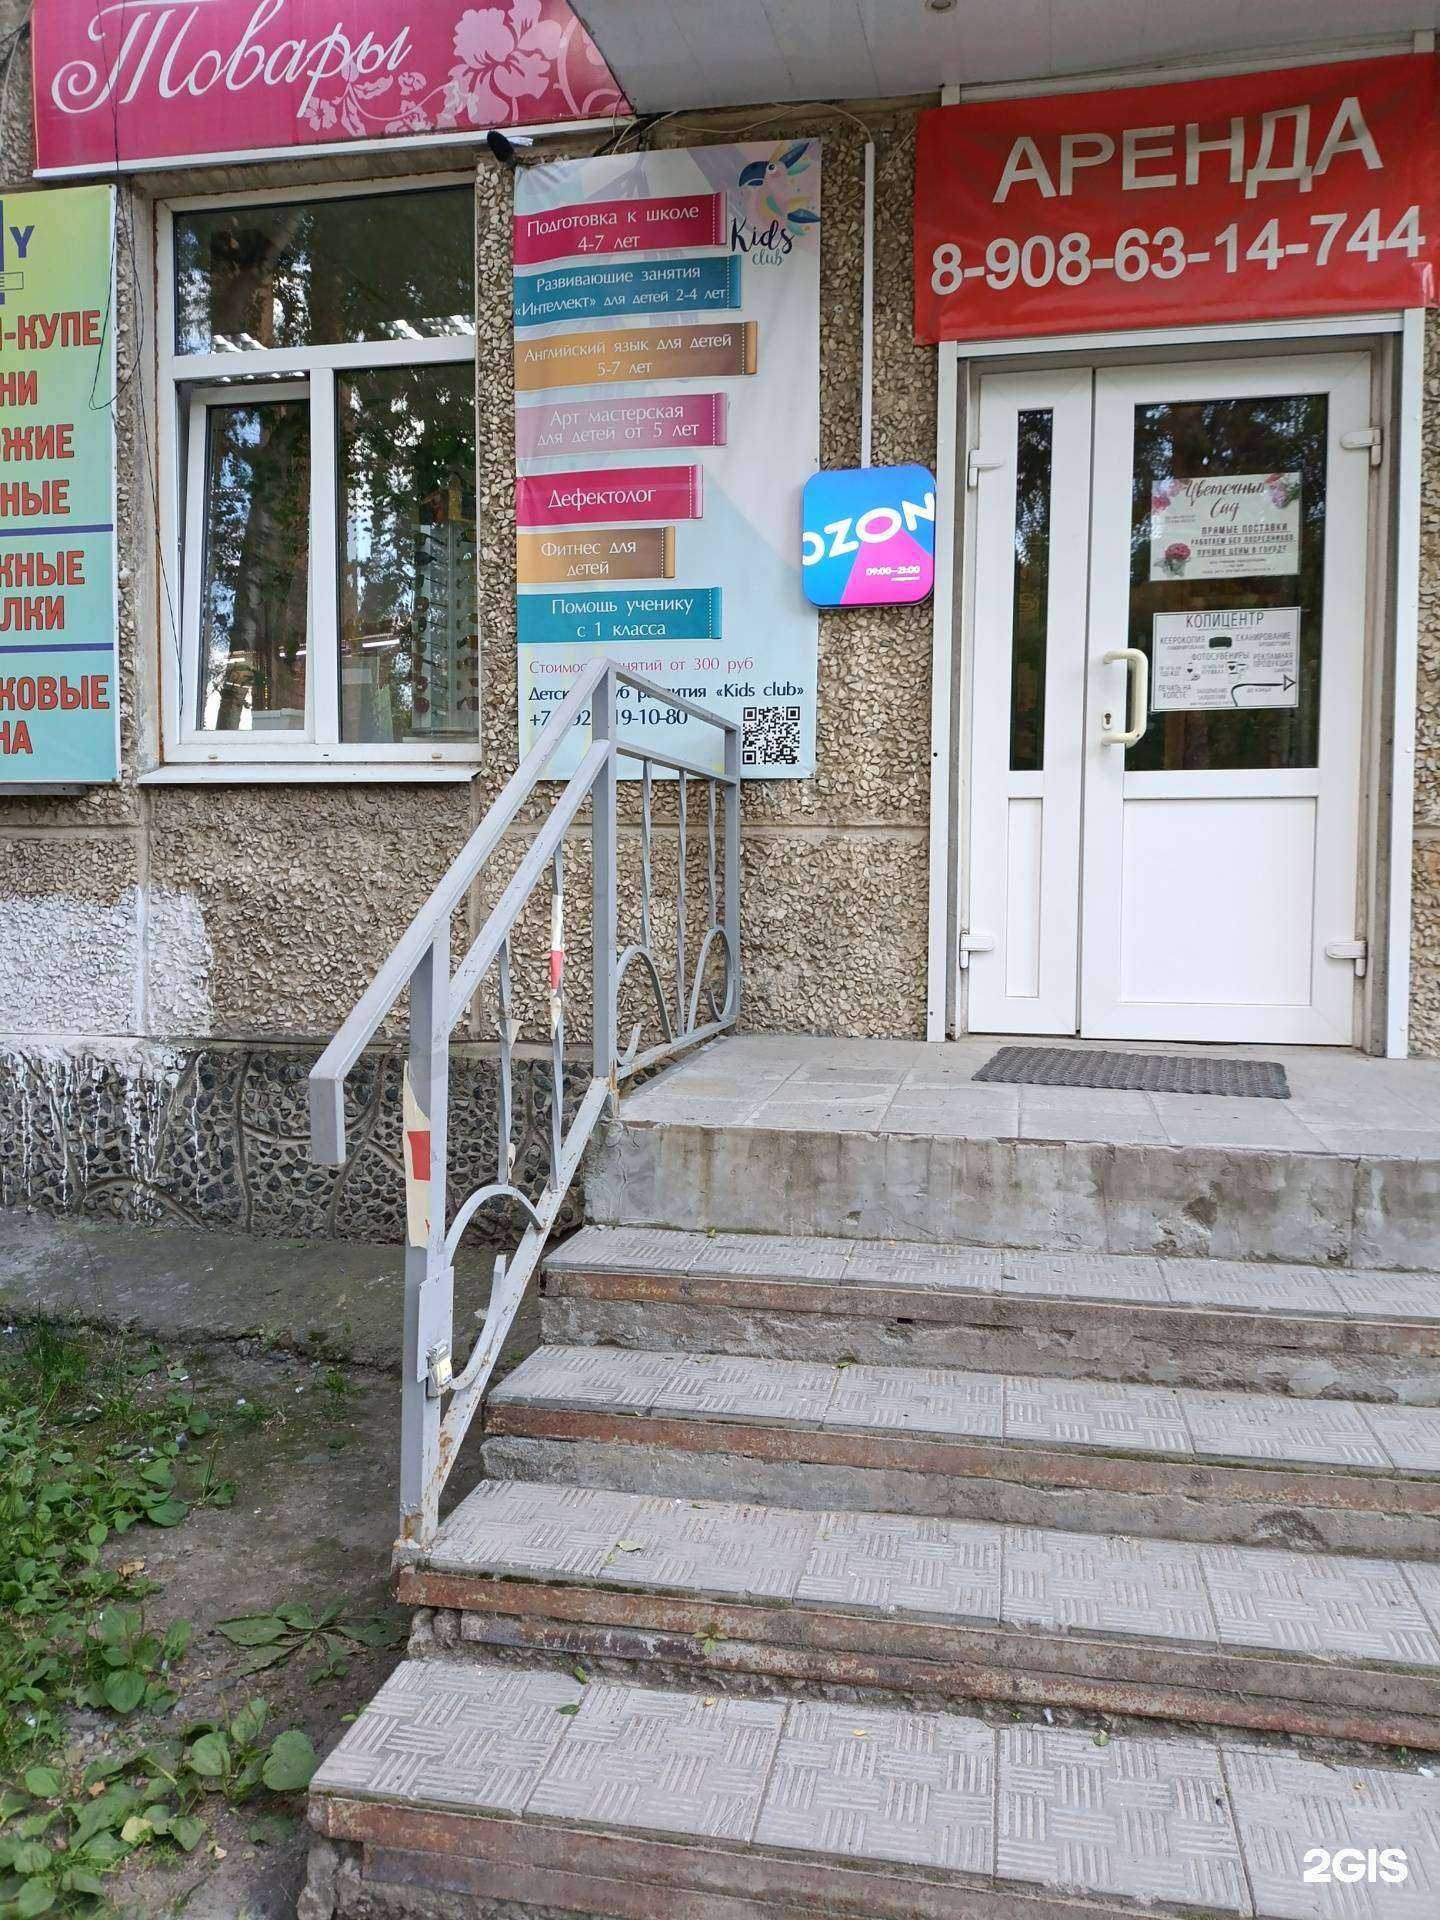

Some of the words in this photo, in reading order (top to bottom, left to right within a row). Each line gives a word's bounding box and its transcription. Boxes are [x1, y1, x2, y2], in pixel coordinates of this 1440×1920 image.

[50, 0, 413, 119] Товары
[992, 96, 1384, 204] АРЕНДА
[527, 212, 618, 237] Подготовка
[628, 212, 637, 223] к
[646, 206, 700, 221] школе
[578, 235, 605, 251] 4-7
[614, 235, 641, 249] лет
[731, 216, 796, 254] Kids
[752, 248, 784, 266] club
[931, 204, 1427, 296] 8-908-63-14-744
[641, 266, 701, 282] занятия
[604, 294, 626, 306] для
[632, 290, 669, 304] детей
[676, 288, 698, 301] 2-4
[704, 289, 726, 301] лет
[0, 310, 103, 350] -КУПЕ
[524, 342, 606, 363] Английский
[613, 338, 649, 354] язык
[656, 337, 682, 351] для
[690, 333, 732, 348] детей
[596, 361, 621, 376] 5-7
[628, 361, 653, 374] лет
[549, 409, 579, 428] Арт
[588, 404, 684, 424] мастерская
[536, 432, 563, 447] для
[571, 427, 616, 444] детей
[625, 426, 642, 438] от
[653, 422, 663, 437] 5
[672, 423, 701, 437] лет
[547, 488, 656, 511] Дефектолог
[802, 492, 935, 567] OZON
[541, 542, 601, 558] Фитнес
[608, 541, 636, 554] для
[566, 561, 609, 576] детей
[626, 597, 694, 616] ученику
[595, 621, 602, 637] 1
[613, 623, 666, 636] класса
[1185, 611, 1265, 628] КОПИЦЕНТР
[670, 659, 686, 671] от
[693, 657, 720, 671] 300
[727, 656, 753, 674] руб
